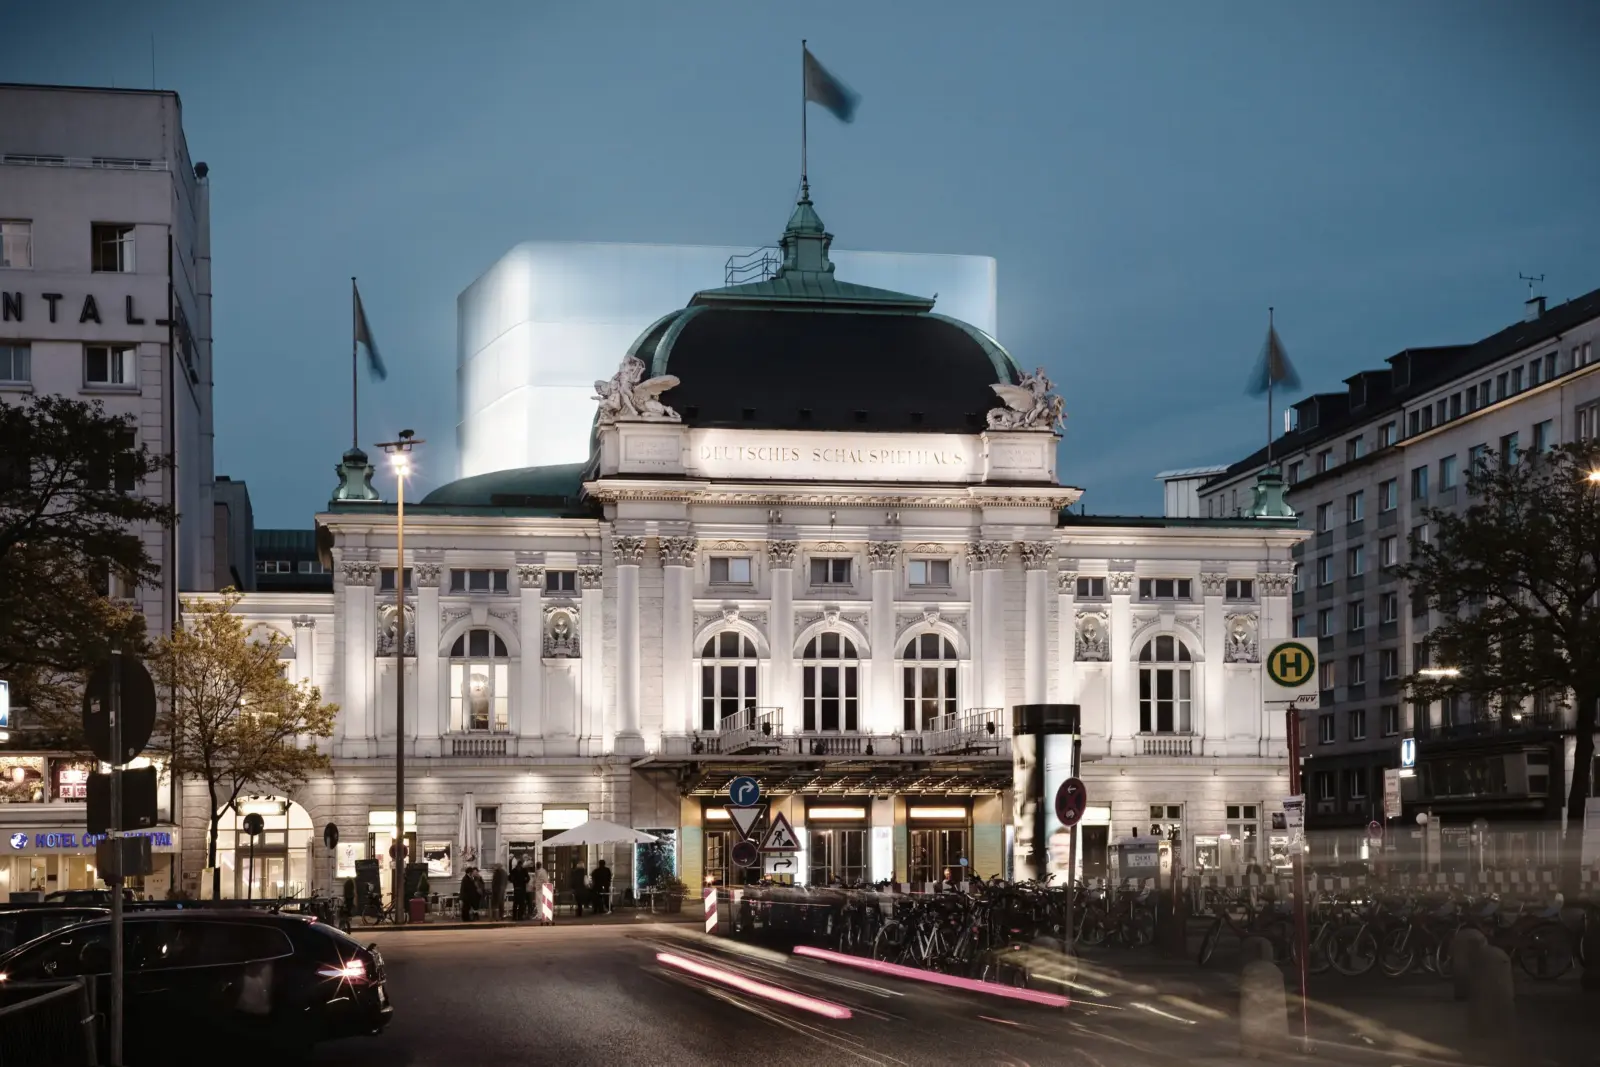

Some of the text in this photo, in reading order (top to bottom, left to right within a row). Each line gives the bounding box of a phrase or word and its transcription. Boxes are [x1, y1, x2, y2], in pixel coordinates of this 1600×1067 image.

[2, 291, 145, 324] NTAL
[700, 446, 799, 461] DEUTSCHES
[1279, 652, 1302, 677] H
[1402, 740, 1414, 765] U
[36, 832, 79, 848] HOTEL
